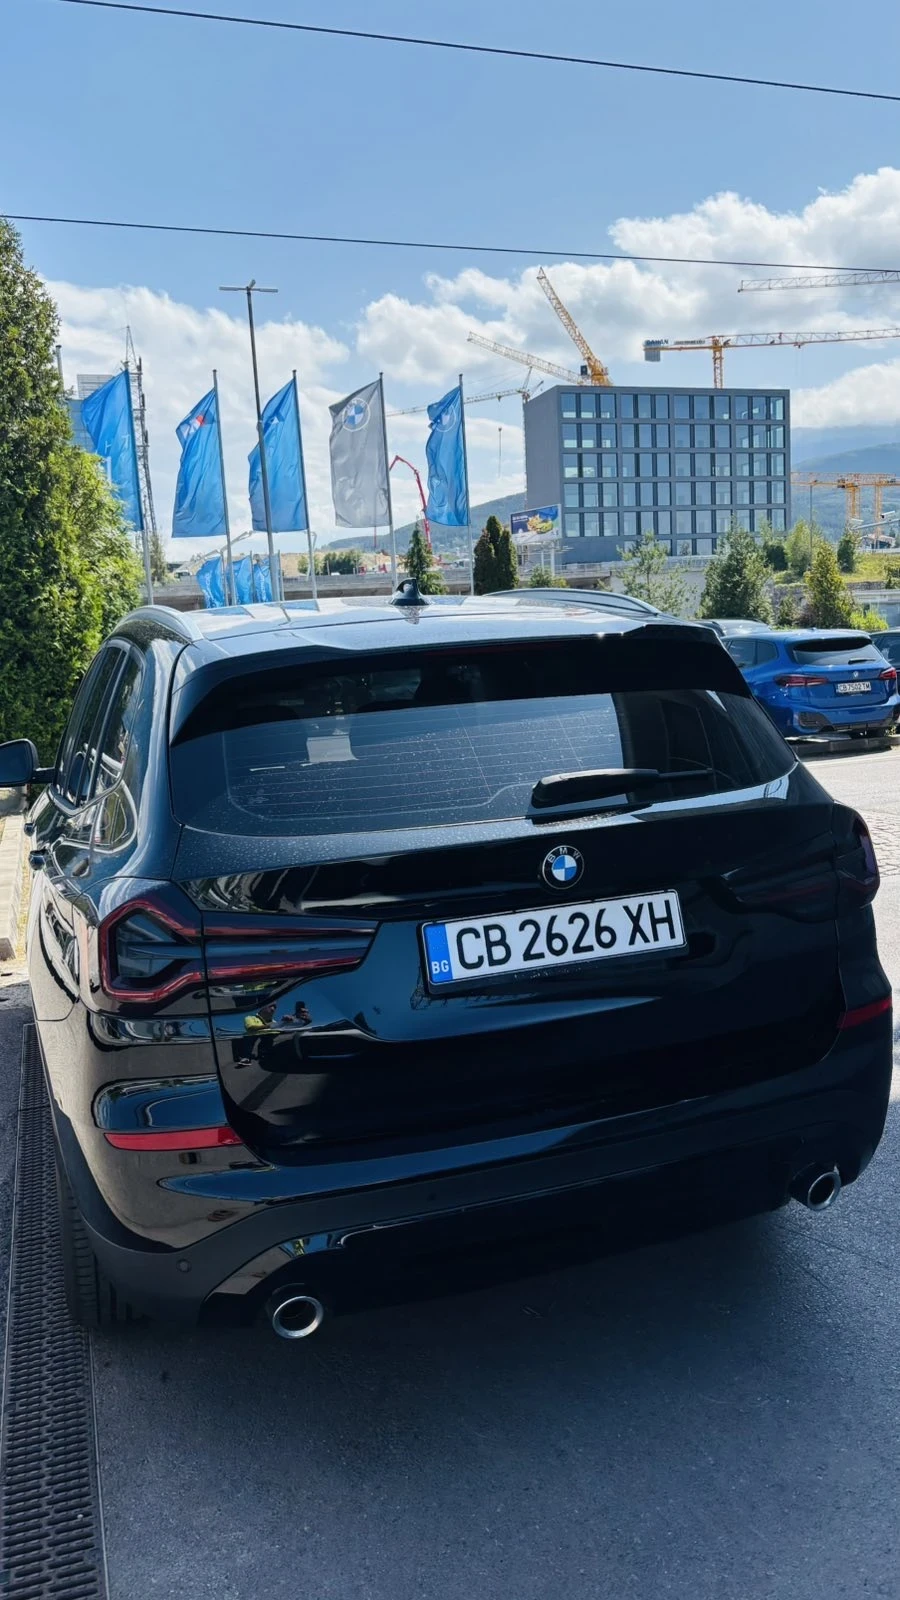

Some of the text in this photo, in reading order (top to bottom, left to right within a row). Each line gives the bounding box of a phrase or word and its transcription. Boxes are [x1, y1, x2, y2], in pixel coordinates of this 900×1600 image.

[547, 847, 581, 863] BMW
[456, 899, 676, 970] CB 2626 XH
[431, 959, 449, 975] BG
